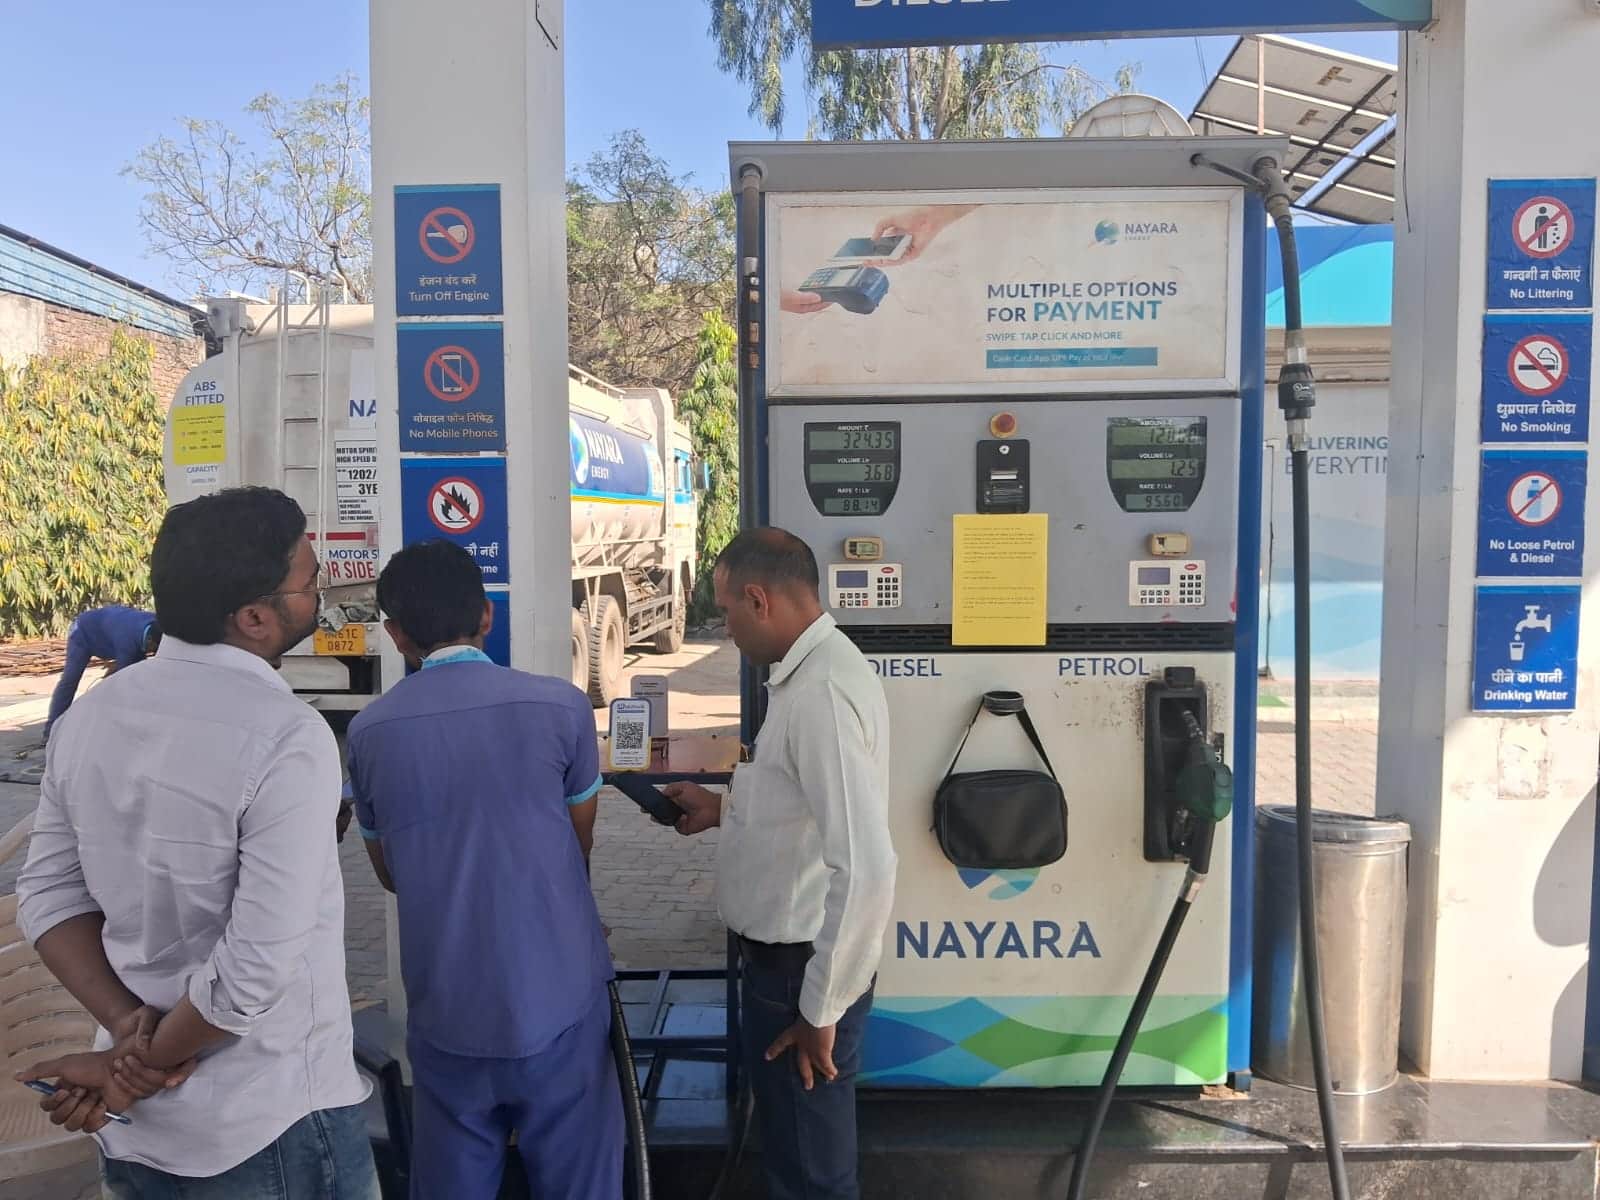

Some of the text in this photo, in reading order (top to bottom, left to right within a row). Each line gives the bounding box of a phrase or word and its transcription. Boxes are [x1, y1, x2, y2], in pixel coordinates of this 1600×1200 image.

[1124, 222, 1178, 235] NAYARA
[1540, 269, 1549, 281] न
[409, 290, 489, 302] Turn Off Engine
[987, 281, 1177, 299] MULTIPLE OPTIONS
[1510, 288, 1573, 300] No Littering
[987, 300, 1162, 322] FOR PAYMENT
[1070, 331, 1092, 341] AND
[1093, 331, 1122, 340] MORE
[193, 380, 216, 392] ABS
[185, 393, 225, 406] FITTED
[413, 412, 445, 423] मोबाइल
[409, 428, 498, 438] No Mobile Phones
[1501, 421, 1571, 434] No Smoking
[843, 431, 893, 449] 324.35
[352, 455, 371, 463] SPEED
[186, 464, 218, 474] CAPACITY
[864, 464, 893, 481] 3.68
[480, 541, 499, 558] नहीं
[1489, 539, 1575, 550] No Loose Petrol
[328, 548, 369, 559] MOTOR
[1509, 553, 1554, 563] & Diesel
[344, 561, 376, 579] SIDE
[327, 640, 354, 651] 0872
[1058, 657, 1150, 677] PETROL
[1491, 668, 1563, 684] पीने का पानी
[1484, 689, 1569, 703] Drinking Water
[896, 920, 1102, 959] NAYARA
